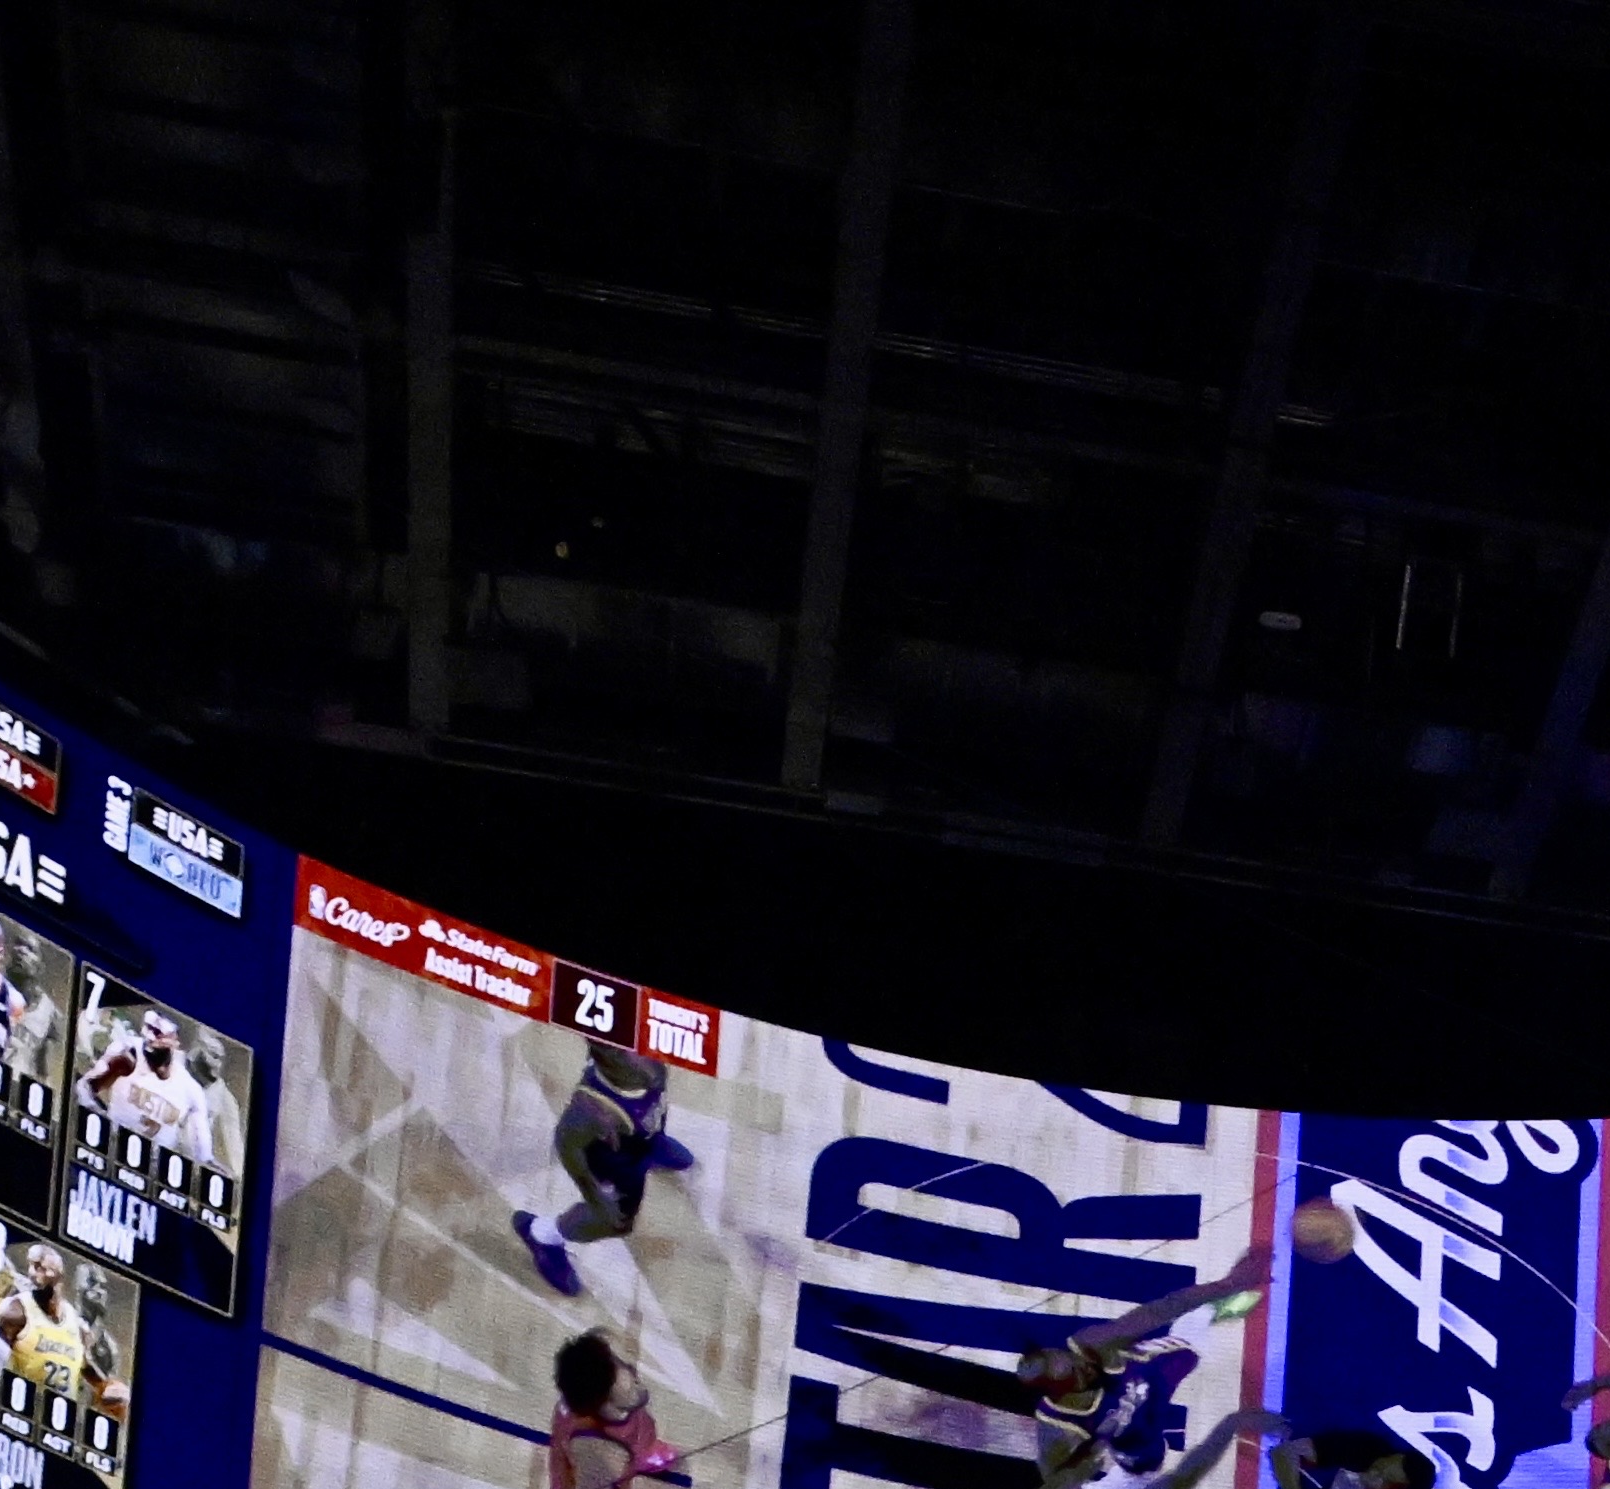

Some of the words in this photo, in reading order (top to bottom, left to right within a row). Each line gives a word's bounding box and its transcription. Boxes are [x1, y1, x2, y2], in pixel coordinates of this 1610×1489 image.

[167, 812, 209, 861] USA
[325, 896, 410, 947] Cares
[86, 970, 107, 1010] 7
[425, 947, 474, 986] Assist
[575, 979, 615, 1033] 25
[647, 1020, 707, 1065] TOTAL
